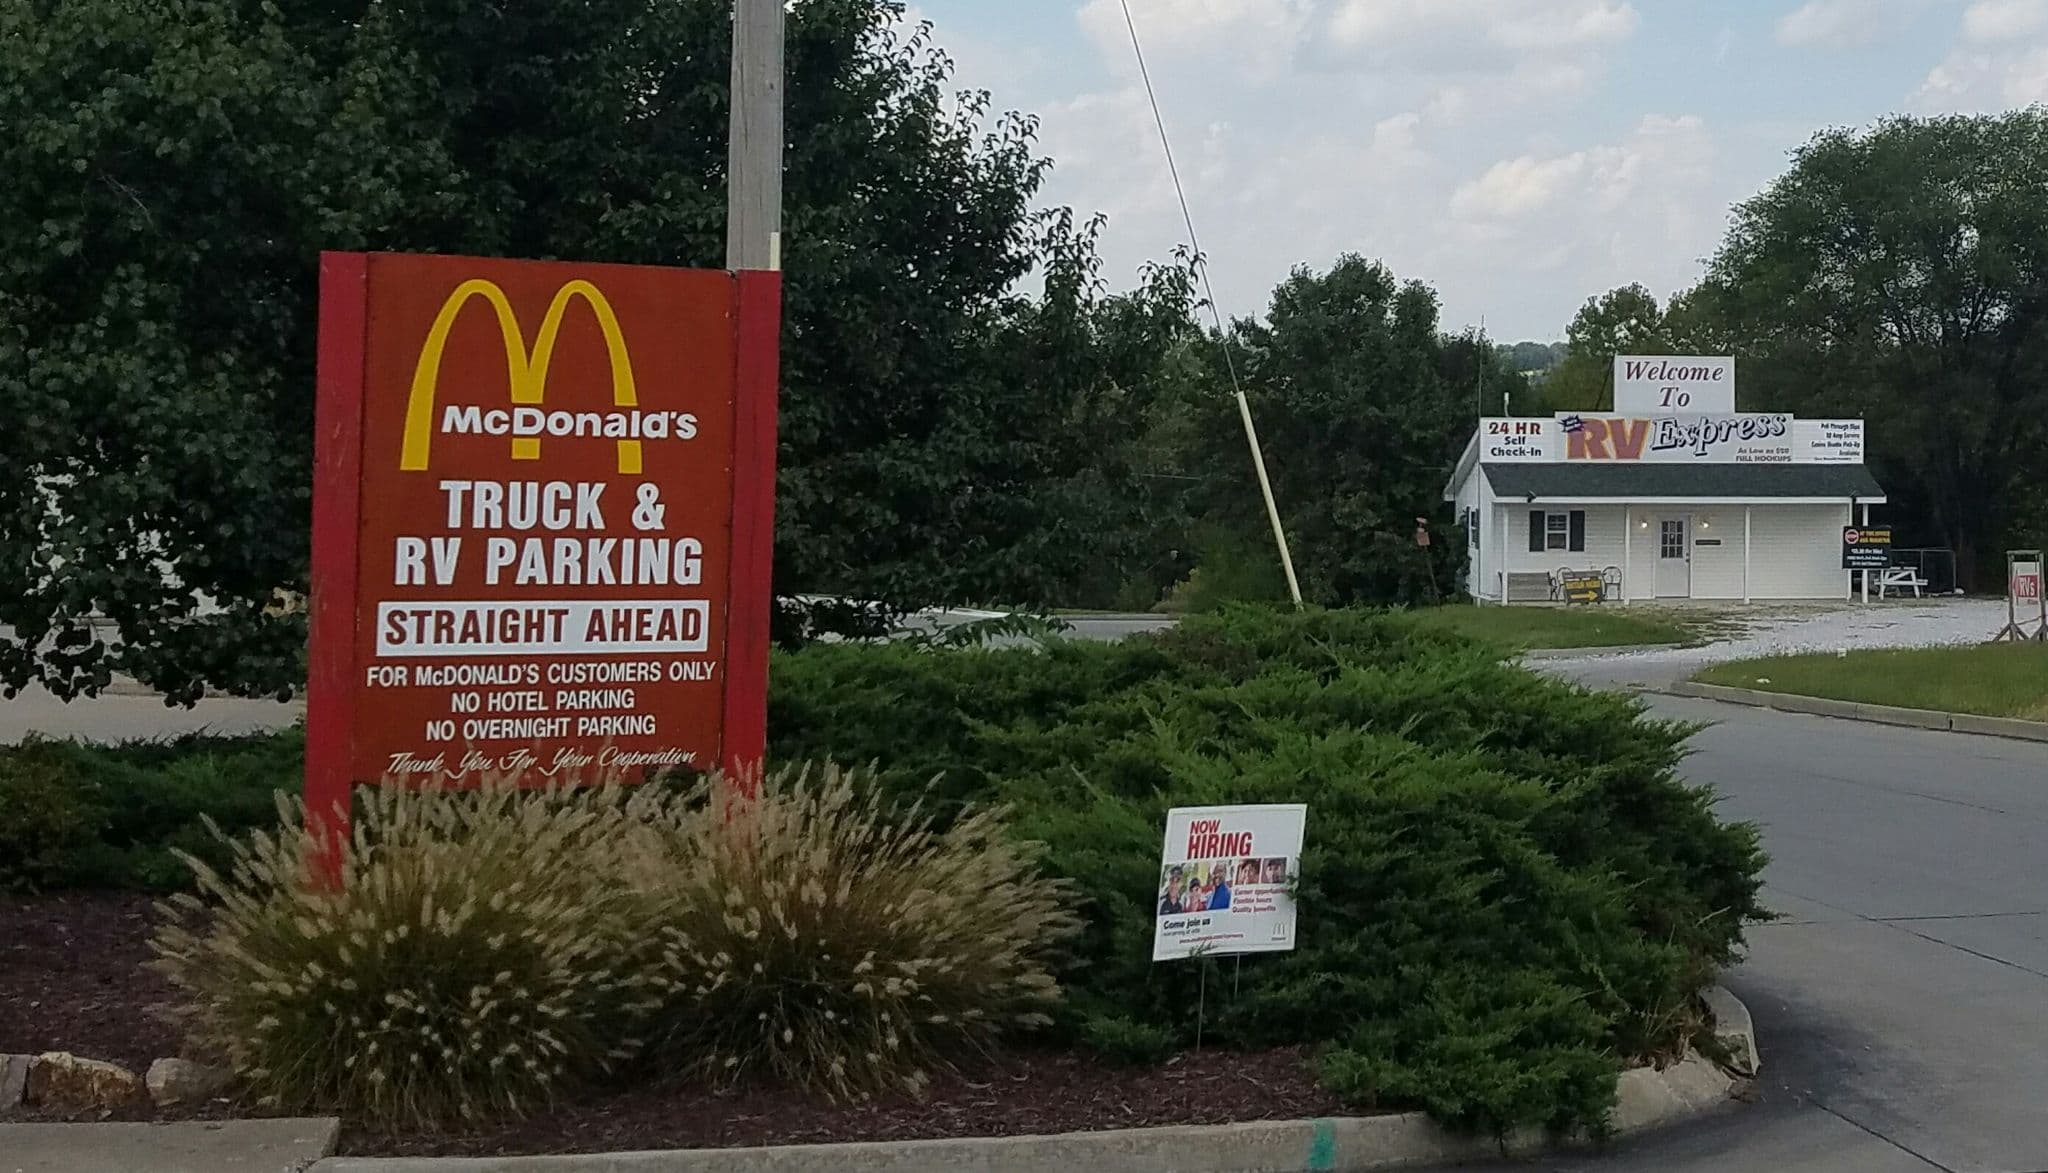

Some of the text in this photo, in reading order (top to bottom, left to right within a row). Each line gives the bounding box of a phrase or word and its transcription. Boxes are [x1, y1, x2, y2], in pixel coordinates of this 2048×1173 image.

[1625, 361, 1724, 381] Welcome
[1659, 387, 1690, 407] To
[442, 405, 698, 440] McDonald's
[1489, 422, 1541, 435] 24 HR
[1504, 436, 1525, 445] Self
[1567, 415, 1787, 460] RV Express
[1491, 447, 1542, 457] Check-In
[440, 480, 666, 531] TRUCK &
[394, 537, 703, 585] RV PARKING
[384, 607, 703, 646] STRAIGHT AHEAD
[366, 661, 717, 688] FOR McDONALD'S CUSTOMERS ONLY
[451, 689, 635, 713] NO HOTEL PARKING
[426, 715, 656, 741] NO OVERNIGHT PARKING
[386, 746, 697, 780] Thank You For Your Cooperation
[1190, 819, 1221, 834] NOW
[1187, 832, 1252, 860] HIRING
[1164, 920, 1185, 930] Come
[1186, 918, 1200, 929] join
